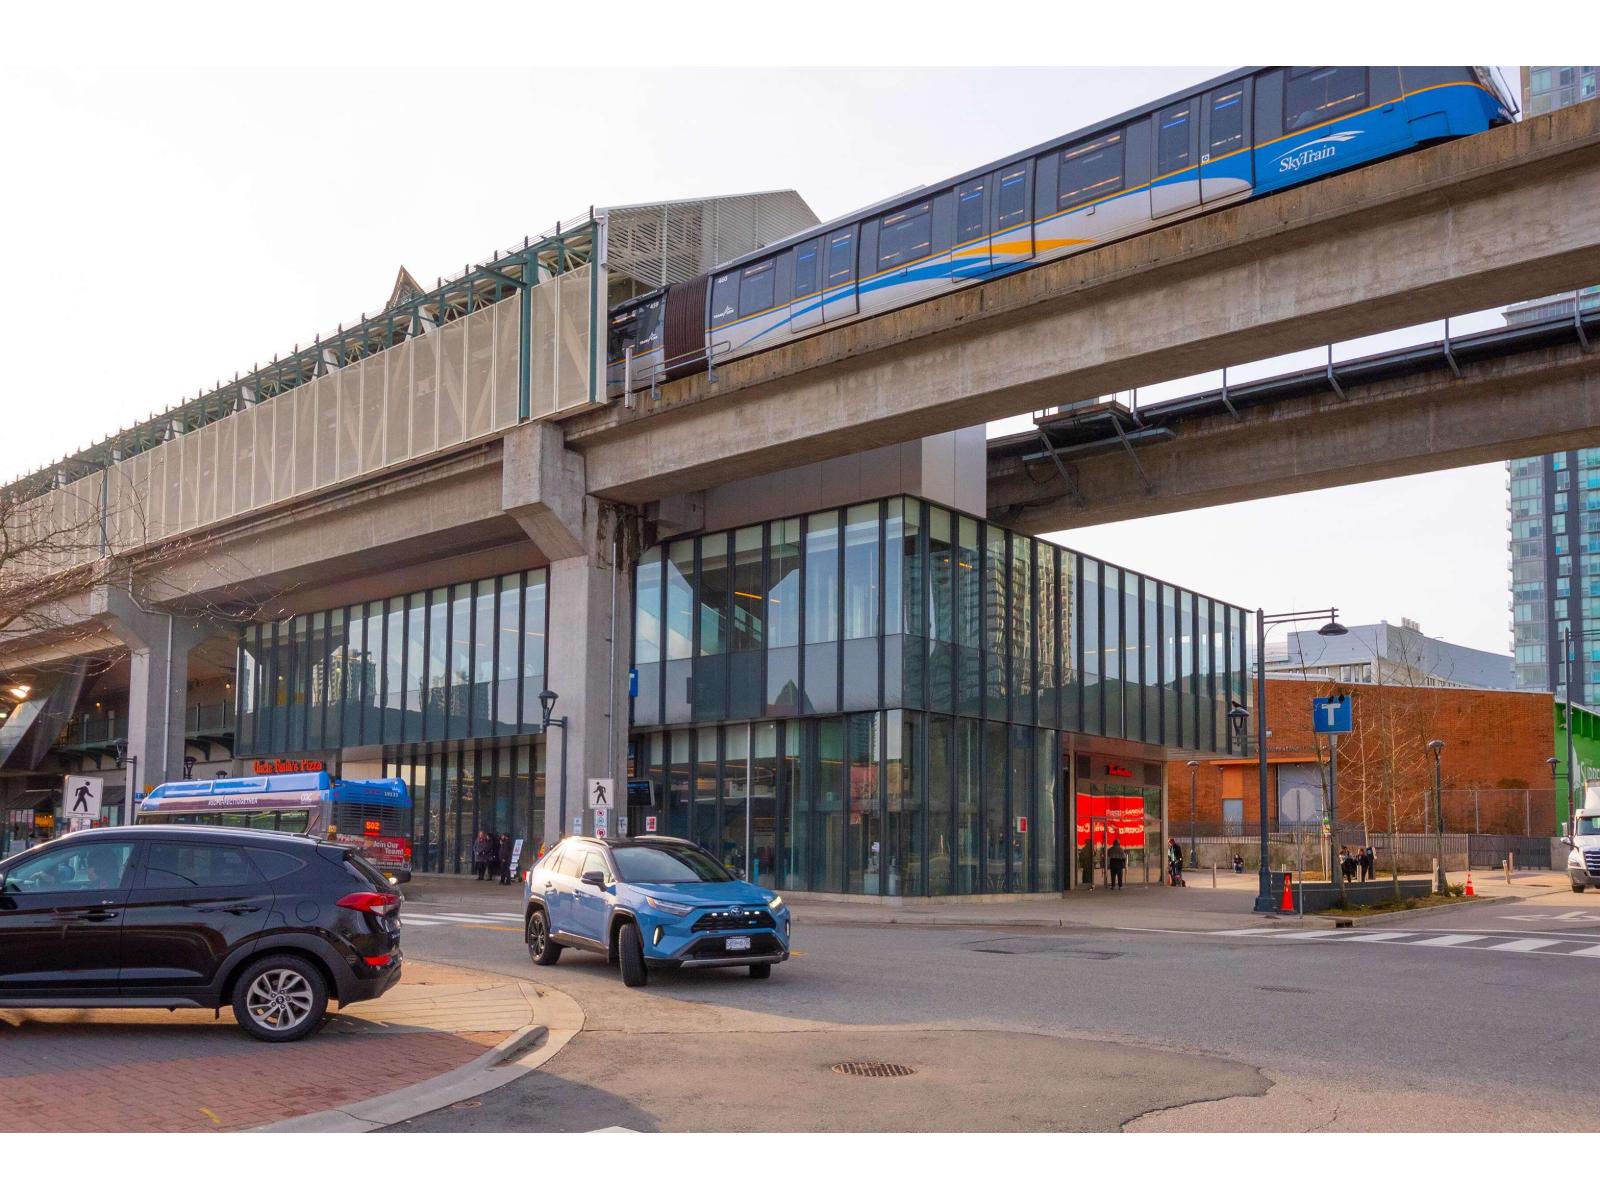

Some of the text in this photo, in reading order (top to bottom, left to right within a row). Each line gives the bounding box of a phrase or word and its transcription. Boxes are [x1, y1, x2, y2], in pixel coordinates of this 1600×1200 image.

[1279, 145, 1336, 173] SkyTrain
[1321, 703, 1342, 726] T
[373, 840, 399, 849] Join Our
